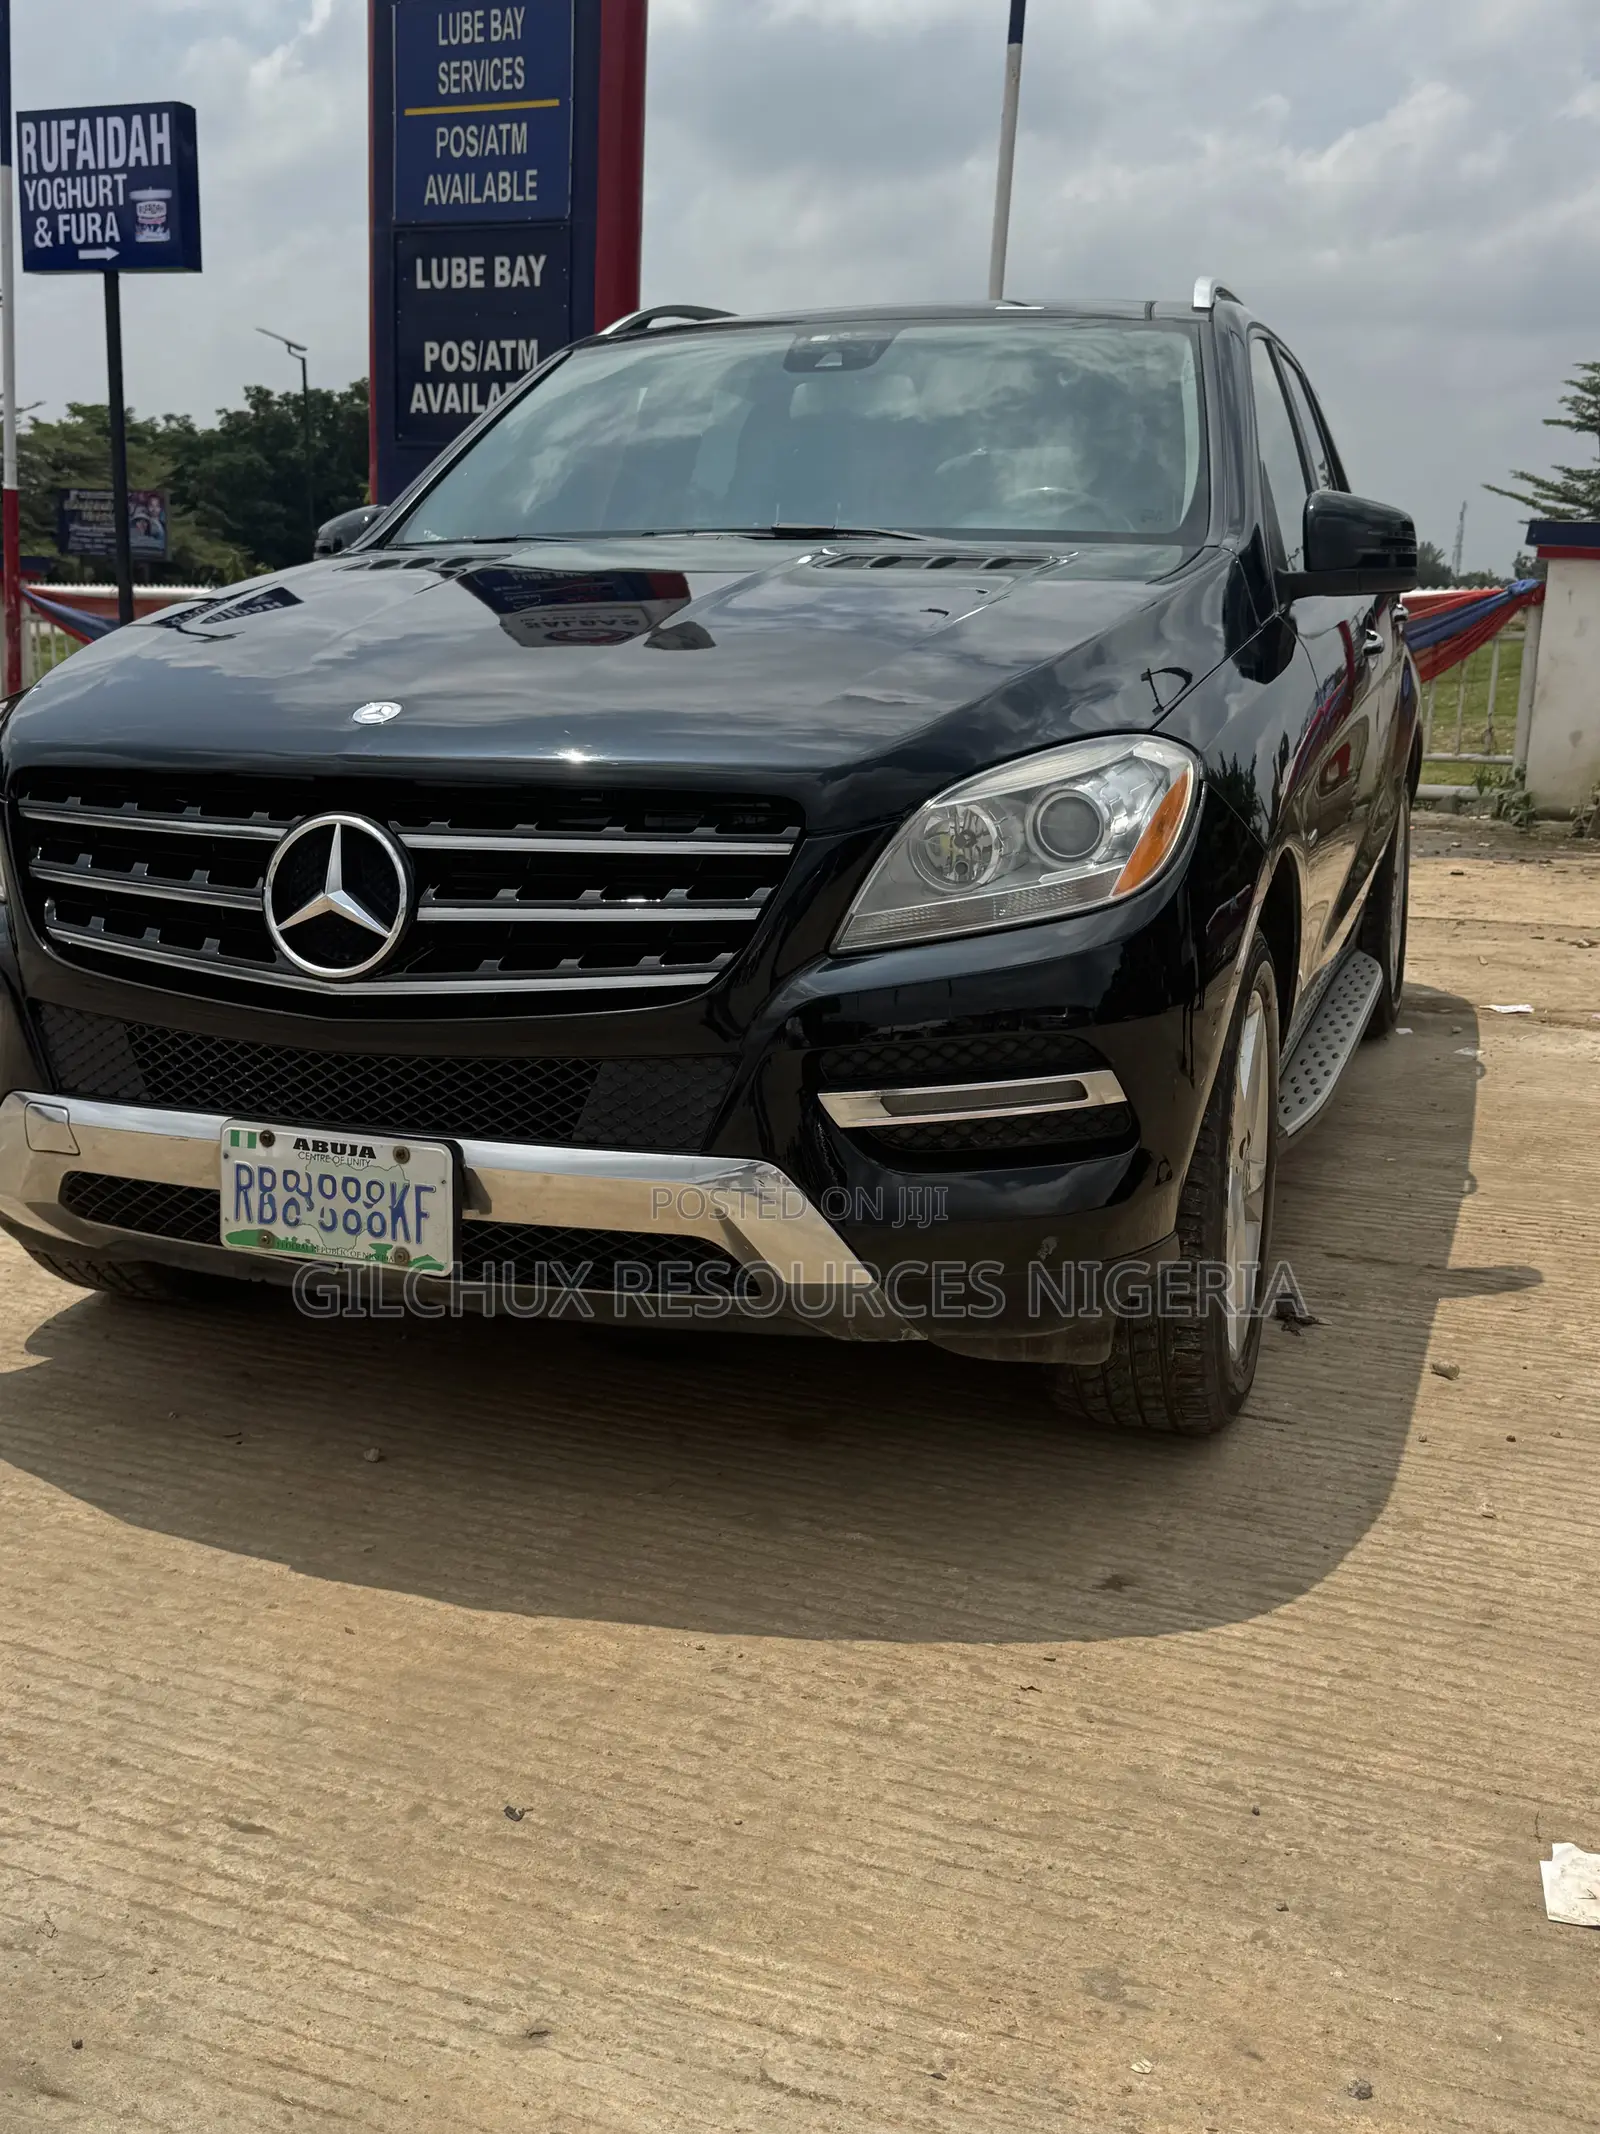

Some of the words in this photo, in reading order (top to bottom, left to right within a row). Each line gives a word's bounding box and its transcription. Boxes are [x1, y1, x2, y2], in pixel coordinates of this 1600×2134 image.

[438, 10, 485, 46] LUBE
[490, 6, 525, 42] BAY
[438, 56, 525, 95] SERVICES
[21, 112, 172, 175] RUFAIDAH
[436, 122, 527, 158] POS/ATM
[24, 173, 127, 211] YOGHURT
[424, 169, 538, 206] AVAILABLE
[34, 217, 53, 248] &
[58, 211, 121, 245] FURA
[416, 256, 485, 289] LUBE
[494, 254, 547, 288] BAY
[424, 339, 539, 372] POS/ATM
[410, 382, 516, 414] AVAILA
[293, 1138, 376, 1159] ABUJA
[298, 1152, 332, 1164] CENTRE
[333, 1154, 345, 1166] OF
[347, 1156, 371, 1168] UNITY
